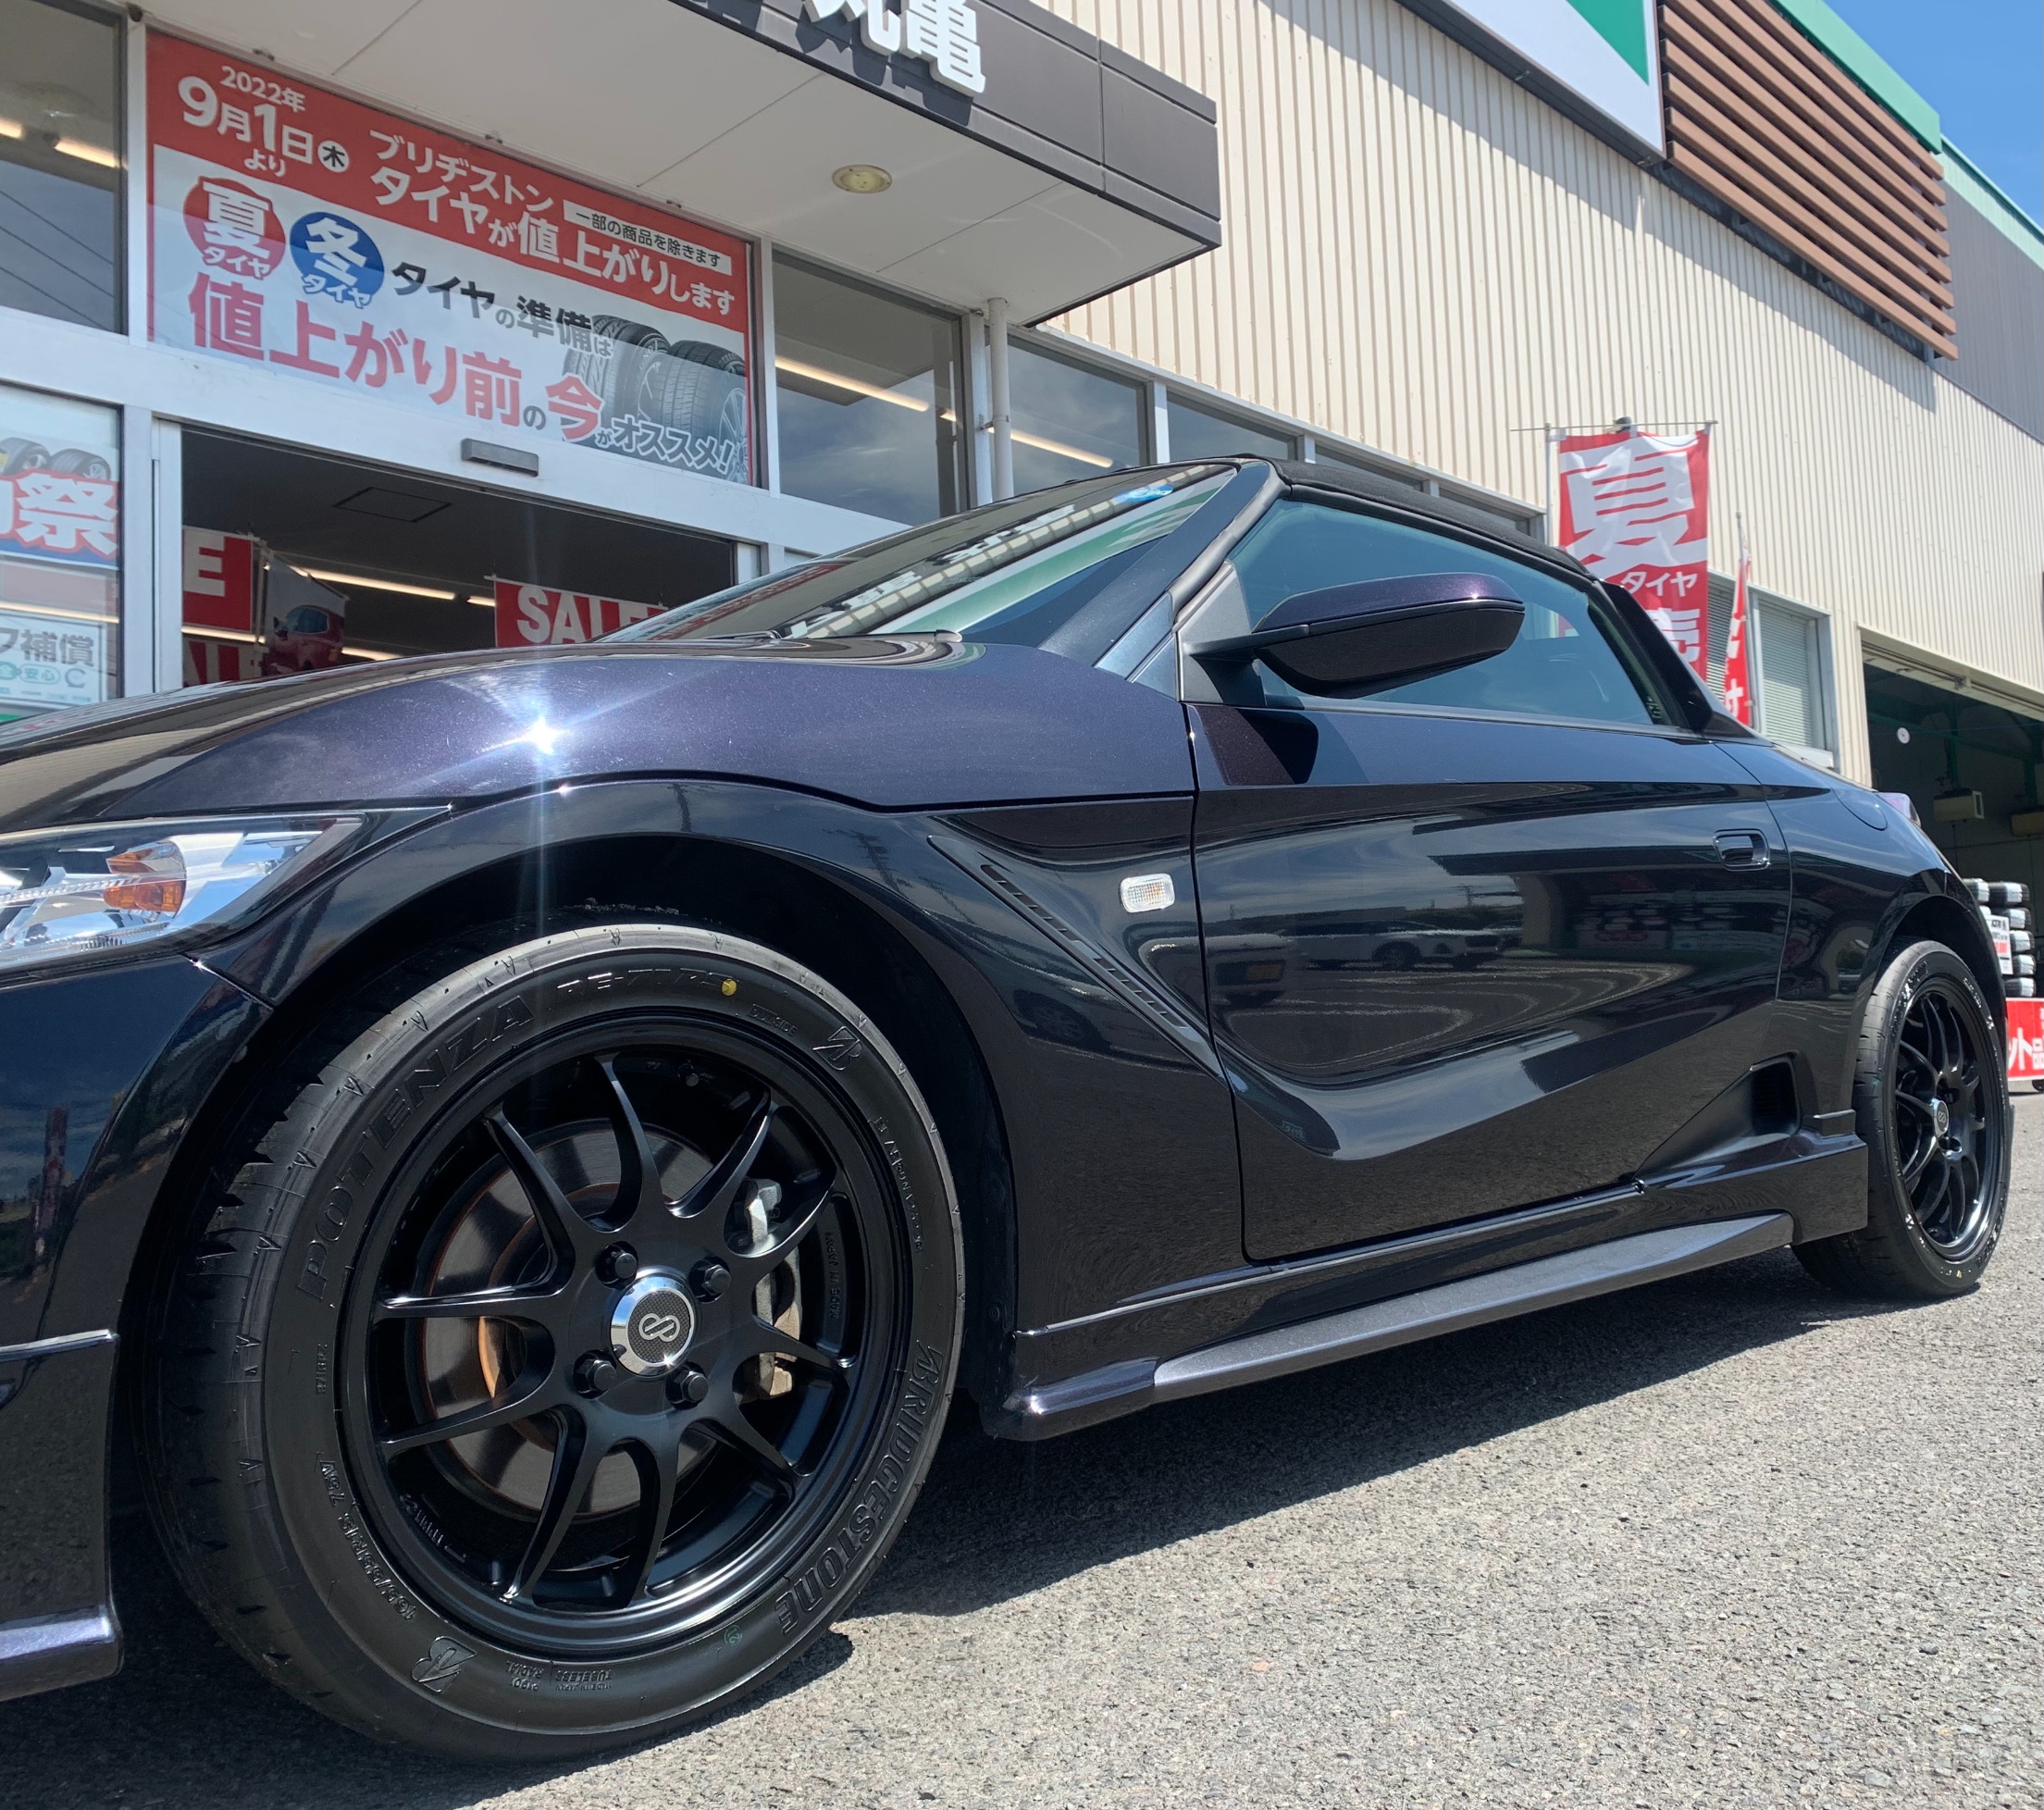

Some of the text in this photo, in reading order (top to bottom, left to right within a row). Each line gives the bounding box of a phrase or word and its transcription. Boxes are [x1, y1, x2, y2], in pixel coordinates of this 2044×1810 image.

[178, 76, 314, 164] 9月1日
[218, 65, 306, 113] 2022年
[243, 149, 286, 177] より
[370, 130, 554, 212] ブリヂストン
[202, 181, 270, 259] 夏
[305, 217, 368, 286] 冬
[370, 165, 735, 316] タイヤが値上がりします
[576, 212, 722, 267] 一部の商品を除きます
[203, 246, 272, 279] タイヤ
[302, 274, 371, 309] タイヤ
[391, 262, 613, 359] タイヤの準備は
[0, 473, 118, 557] 祭
[1620, 570, 1698, 599] タイヤ
[748, 1002, 798, 1037] OUTSIDE
[296, 995, 536, 1302] POTENZA
[774, 1340, 945, 1635] BRIDGESTONE
[319, 1459, 416, 1621] 165/55R15 75V
[554, 1668, 613, 1682] TUBELESS
